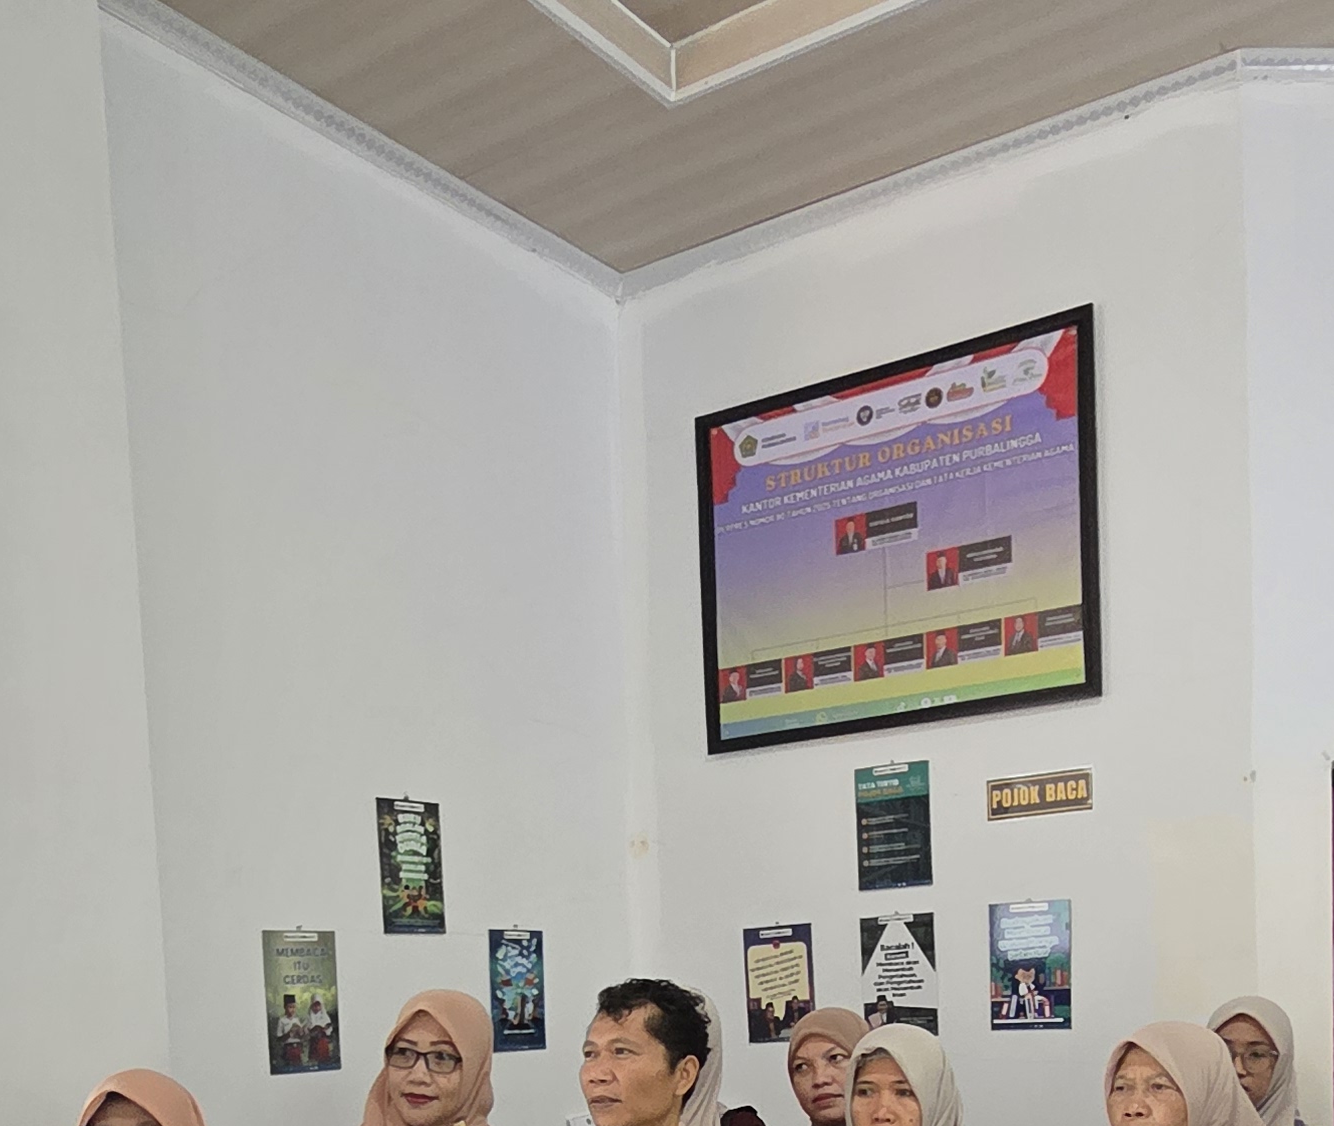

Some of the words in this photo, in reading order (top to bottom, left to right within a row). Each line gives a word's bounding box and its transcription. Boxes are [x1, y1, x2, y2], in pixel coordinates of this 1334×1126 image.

[741, 496, 782, 515] KANTOR
[783, 480, 855, 506] KEMENTERIAN
[855, 468, 893, 488] AGAMA
[894, 451, 961, 479] KABUPATEN
[961, 432, 1043, 462] PURBALINGGA
[764, 451, 871, 492] STRUKTUR
[877, 414, 1013, 463] ORGANISASI
[991, 786, 1041, 809] POJOK
[1045, 779, 1088, 803] BACA
